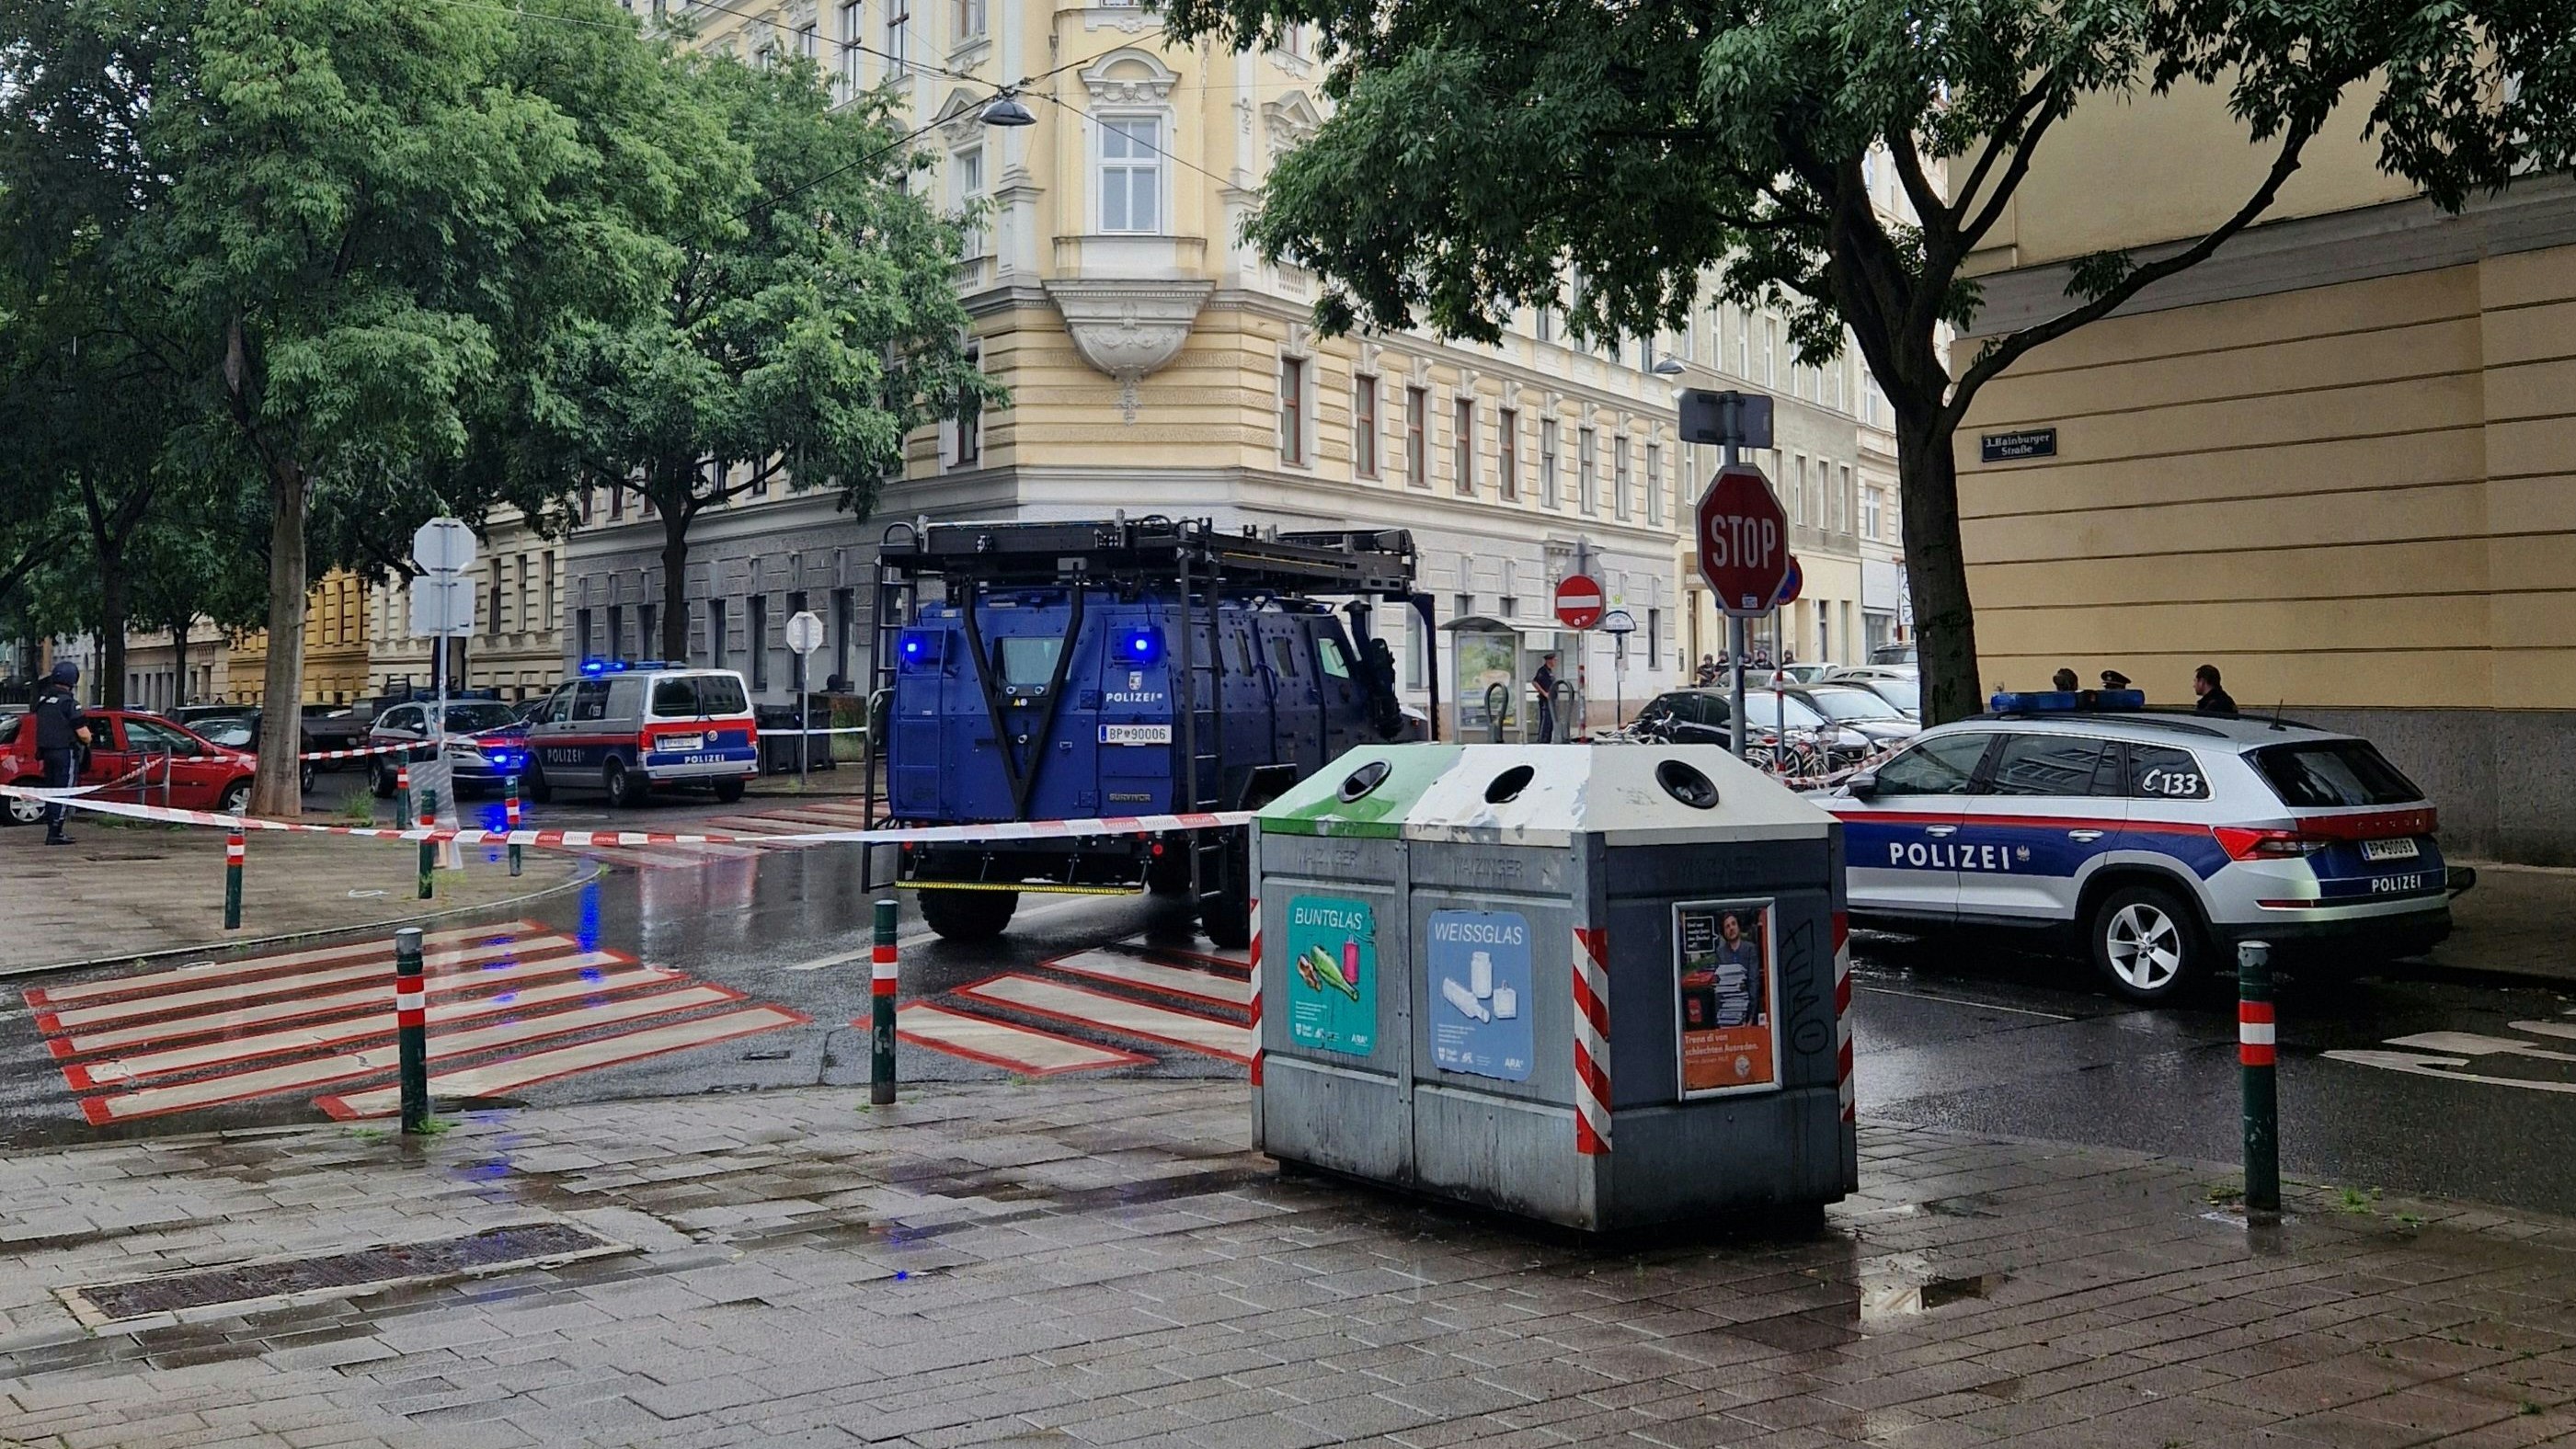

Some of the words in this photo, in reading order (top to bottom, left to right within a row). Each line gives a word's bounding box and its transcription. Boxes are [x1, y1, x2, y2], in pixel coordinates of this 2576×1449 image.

[1711, 514, 1777, 569] STOP
[1105, 692, 1155, 702] POLIZEI
[1109, 728, 1123, 740] BP
[1131, 728, 1165, 740] 90006
[547, 748, 582, 763] POLIZEI
[684, 754, 725, 764] POLIZEI
[2161, 773, 2198, 794] 133
[1109, 793, 1151, 803] SURVIVOR
[1889, 842, 2010, 871] POLIZEI
[2372, 873, 2421, 893] POLIZEI
[1295, 907, 1363, 930] BUNTGLAS
[1435, 922, 1523, 945] WEISSGLAS
